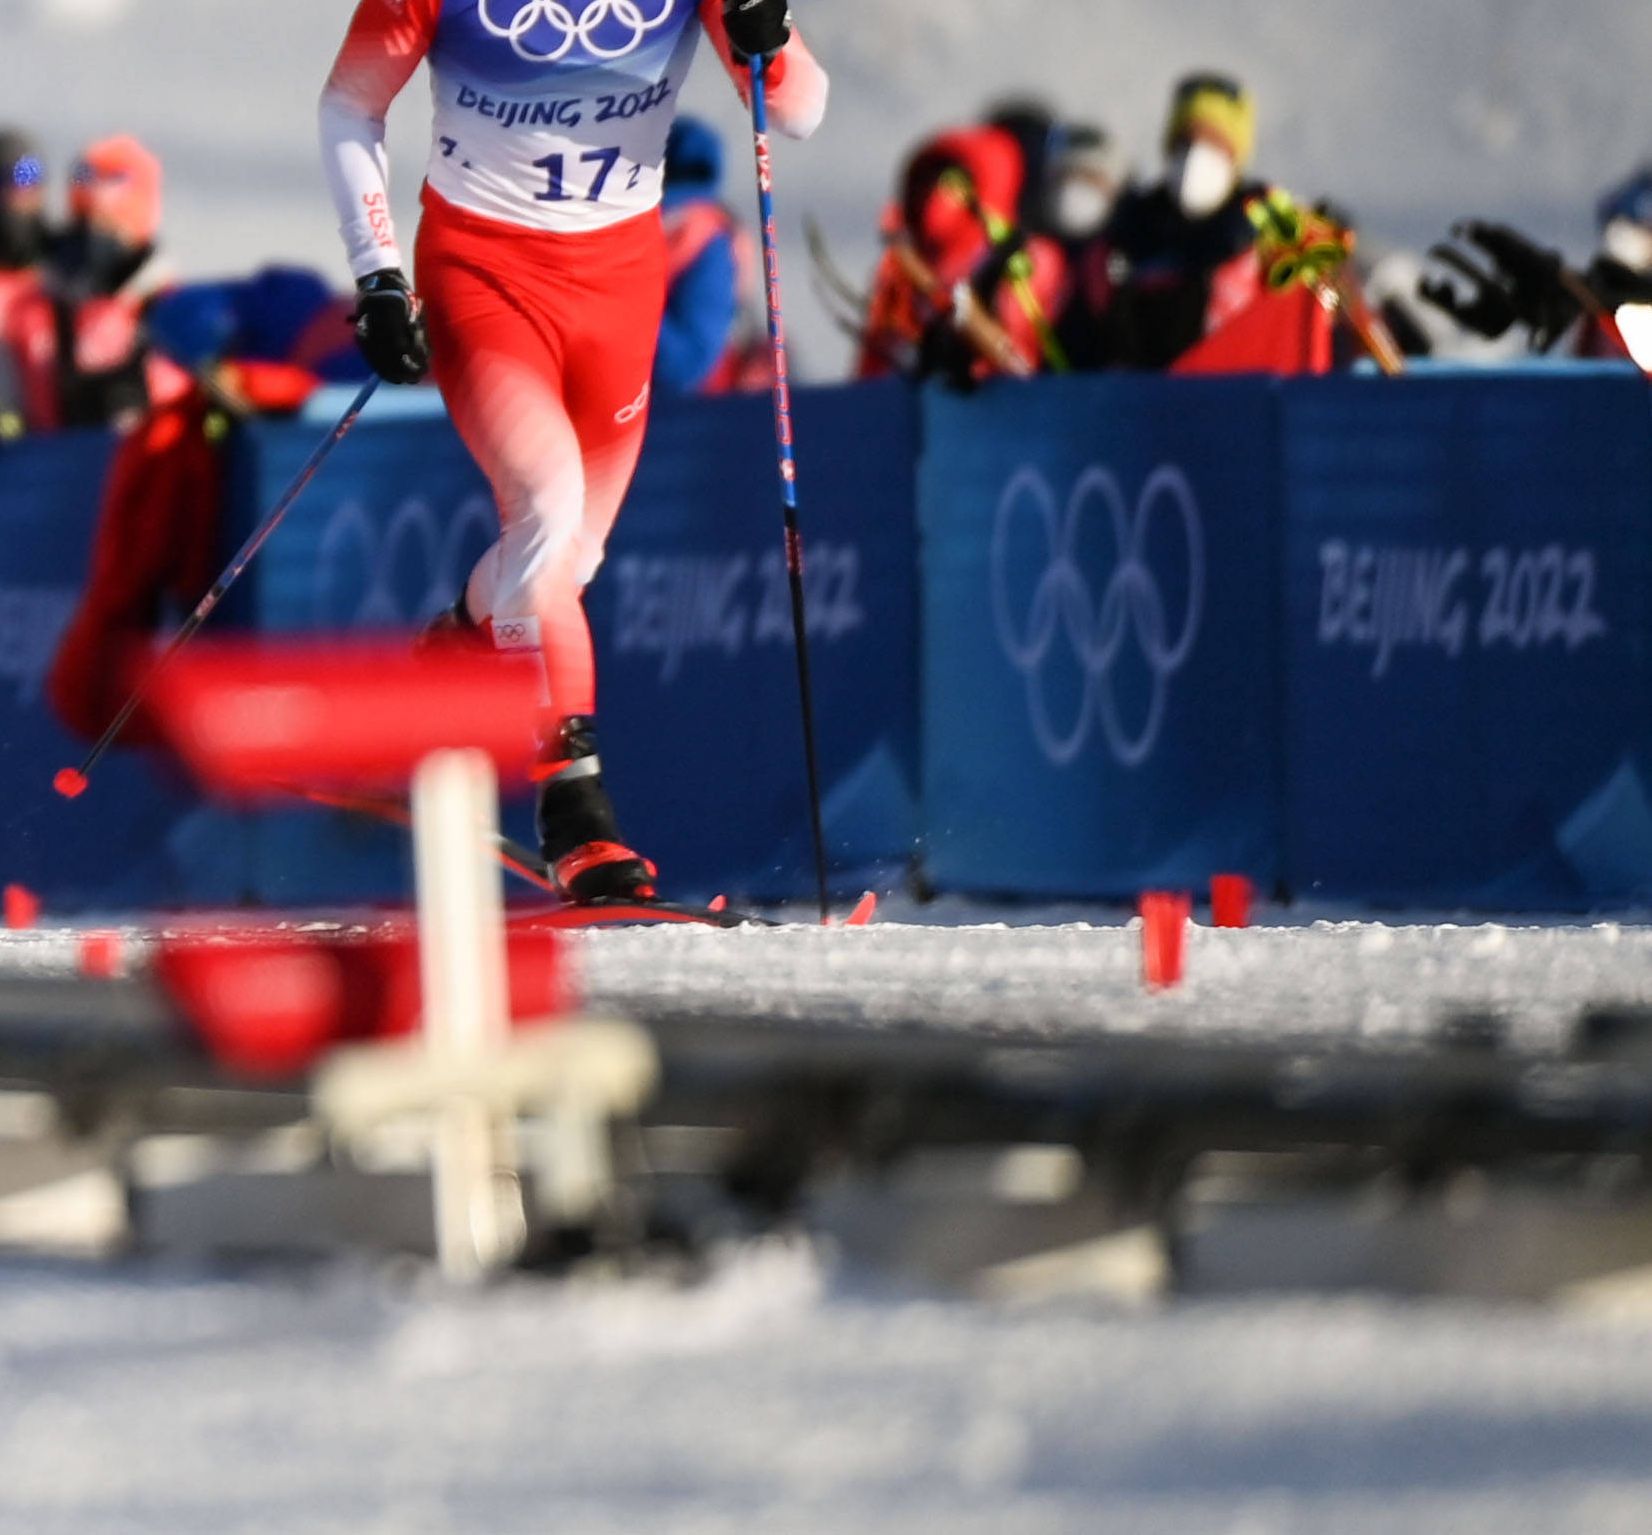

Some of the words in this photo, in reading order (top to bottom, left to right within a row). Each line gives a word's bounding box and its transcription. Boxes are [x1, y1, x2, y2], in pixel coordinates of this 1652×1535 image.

[456, 84, 583, 128] BEIJING
[595, 77, 673, 124] 2022
[1318, 539, 1468, 679] BEIJING
[1479, 542, 1607, 649] 2022
